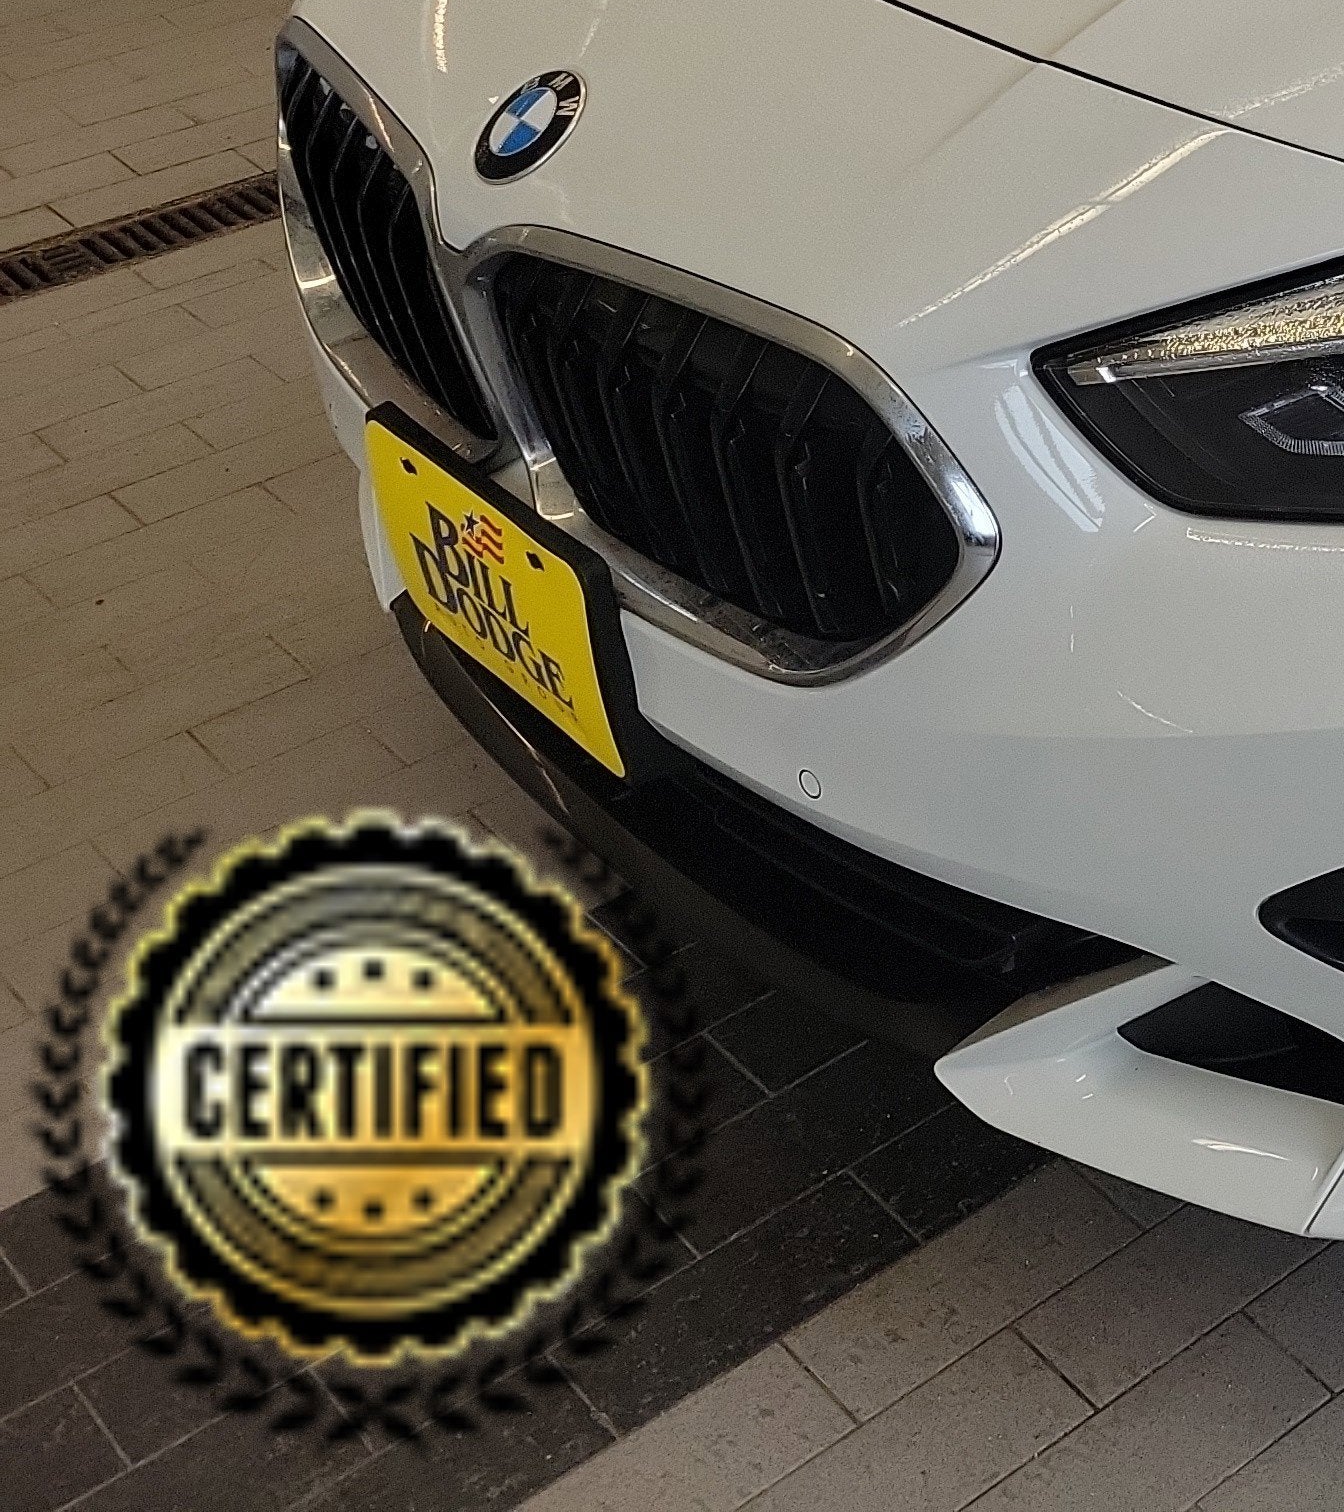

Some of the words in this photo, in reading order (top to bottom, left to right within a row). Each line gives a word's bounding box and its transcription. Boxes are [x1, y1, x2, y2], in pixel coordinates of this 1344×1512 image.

[520, 72, 580, 116] BMW
[409, 531, 575, 711] DODGE
[425, 500, 530, 639] BILL
